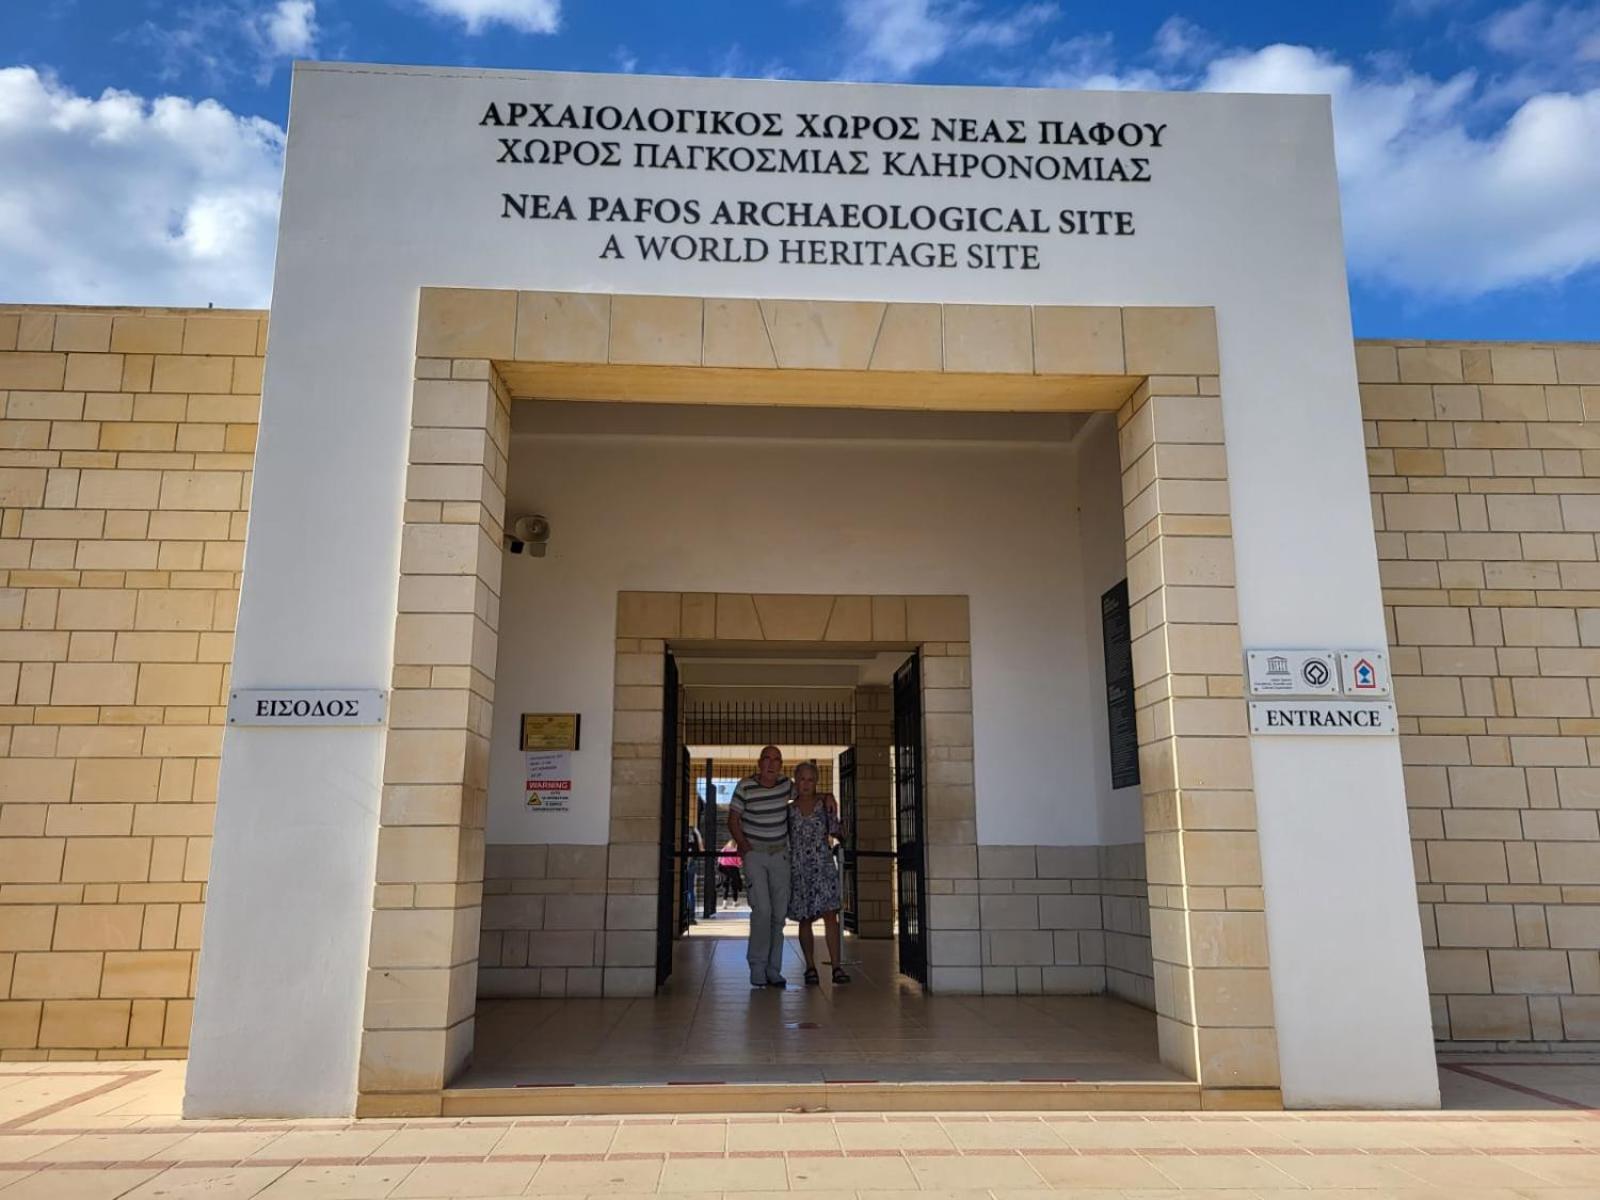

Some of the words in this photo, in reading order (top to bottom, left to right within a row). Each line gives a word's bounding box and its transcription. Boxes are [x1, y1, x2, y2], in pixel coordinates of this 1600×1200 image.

[479, 101, 785, 137] ΑΡΧΑΙΟΛΟΓΙΚΟΣ
[796, 113, 920, 141] ΧΩΡΟΣ
[931, 117, 1027, 144] ΝΕΑΣ
[1039, 120, 1168, 148] ΠΑΦΟΥ
[496, 138, 622, 167] ΧΩΡΟΣ
[634, 143, 869, 176] ΠΑΓΚΟΣΜΙΑΣ
[883, 151, 1152, 183] ΚΛΗΡΟΝΟΜΙΑΣ
[502, 192, 577, 221] NEA
[588, 197, 701, 225] PAFOS
[711, 200, 1051, 234] ARCHAEOLOGICAL
[1059, 209, 1136, 236] SITE
[599, 234, 625, 259] A
[635, 234, 769, 265] WORLD
[780, 239, 958, 269] HERITAGE
[968, 243, 1040, 270] SITE
[255, 699, 360, 718] ΕΙΣΟΔΟΣ
[1266, 709, 1382, 728] ENTRANCE
[528, 782, 569, 790] WARNING
